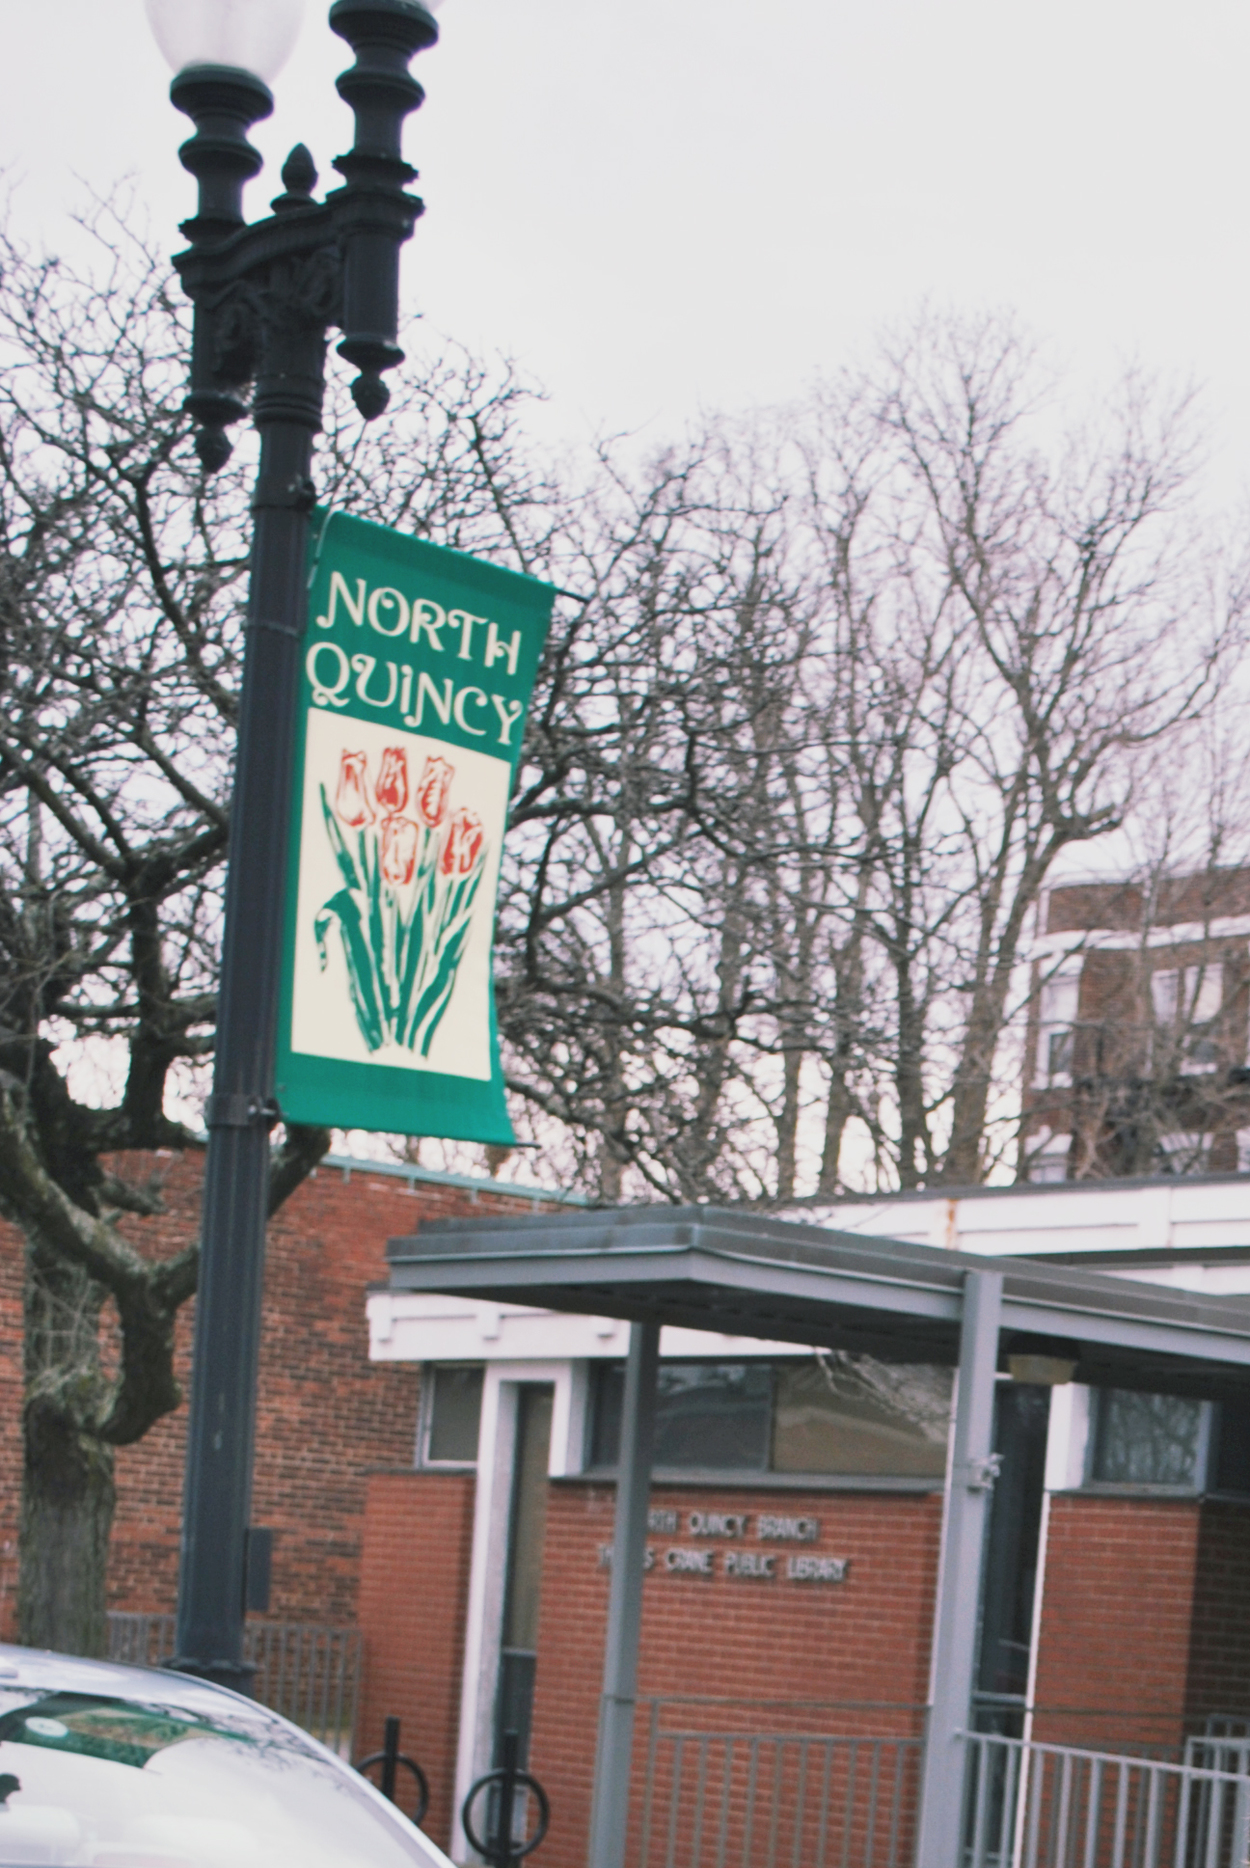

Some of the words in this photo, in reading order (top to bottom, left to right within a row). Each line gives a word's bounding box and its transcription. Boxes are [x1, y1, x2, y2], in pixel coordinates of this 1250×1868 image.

[316, 571, 522, 675] NORTH
[306, 641, 524, 746] QUINCY
[688, 1511, 747, 1538] QUINCY
[757, 1514, 819, 1541] BRANCH
[666, 1547, 714, 1574] CRANE
[724, 1551, 776, 1578] PUBLIC
[788, 1555, 849, 1582] LIBRARY
